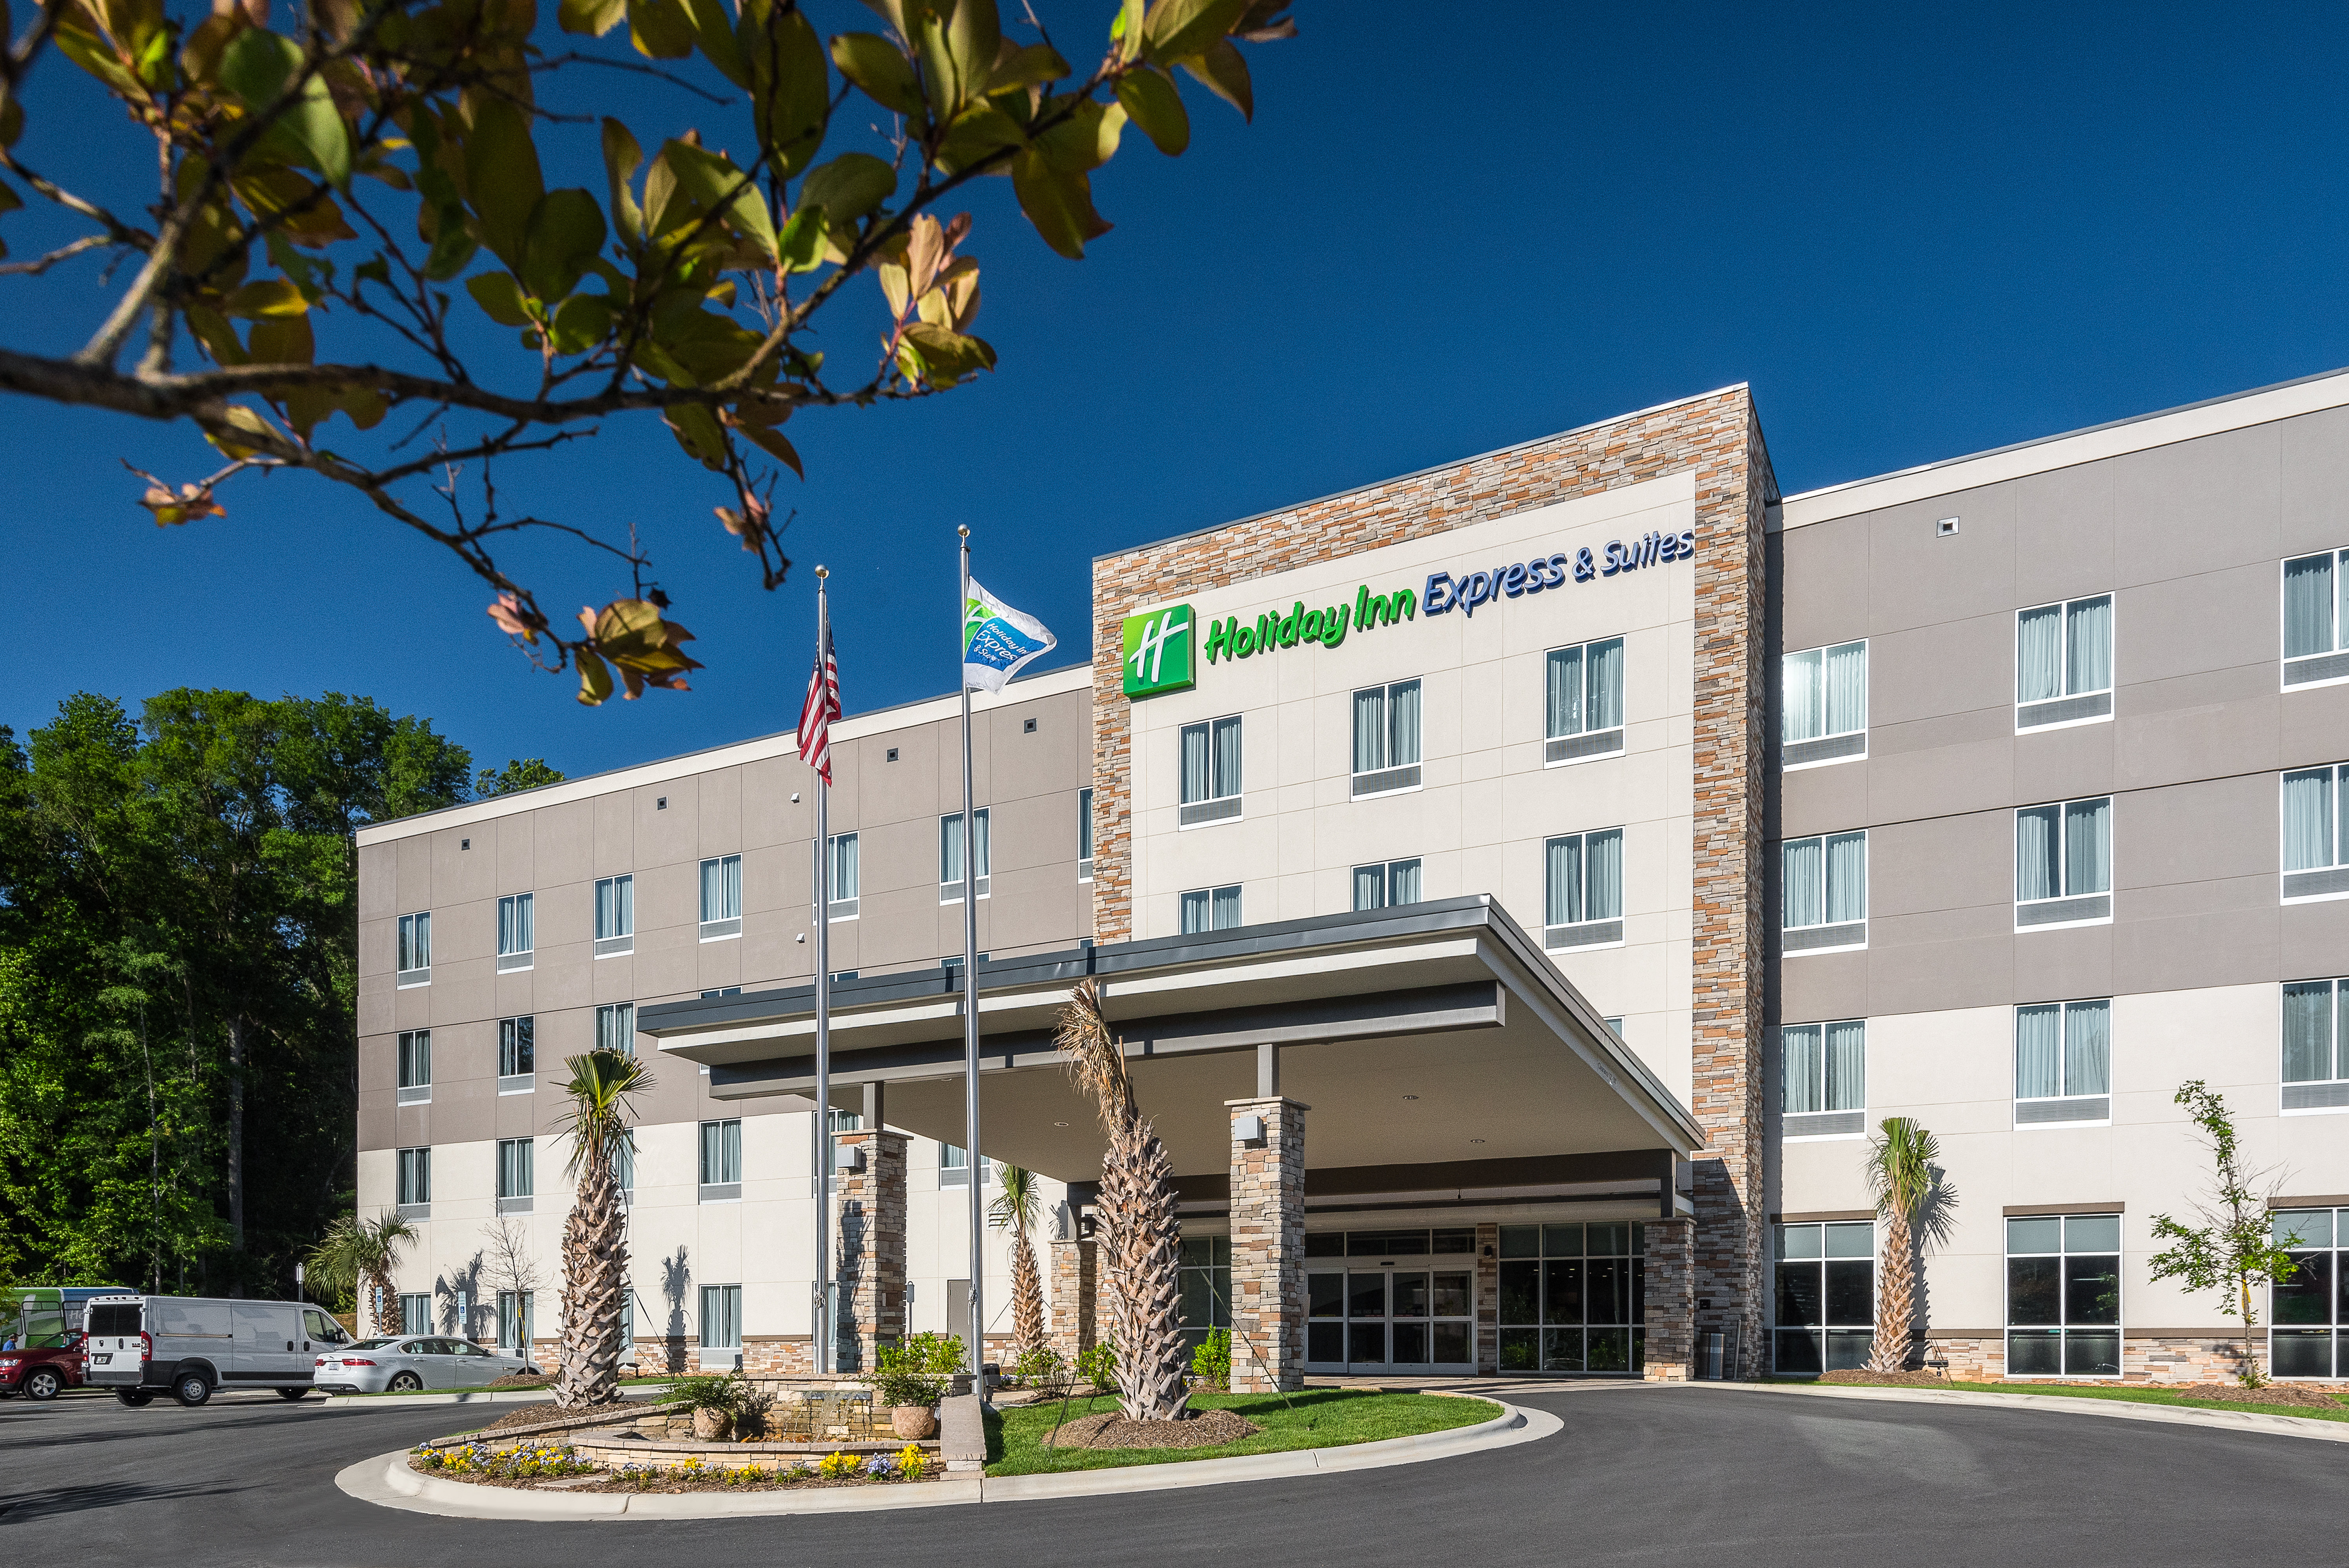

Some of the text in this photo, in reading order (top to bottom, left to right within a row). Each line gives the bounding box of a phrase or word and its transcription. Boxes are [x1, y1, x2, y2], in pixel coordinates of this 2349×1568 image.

[1204, 529, 1694, 664] Holiday Inn Express & Suites
[975, 630, 1018, 661] Expres
[986, 623, 1019, 650] Holiday
